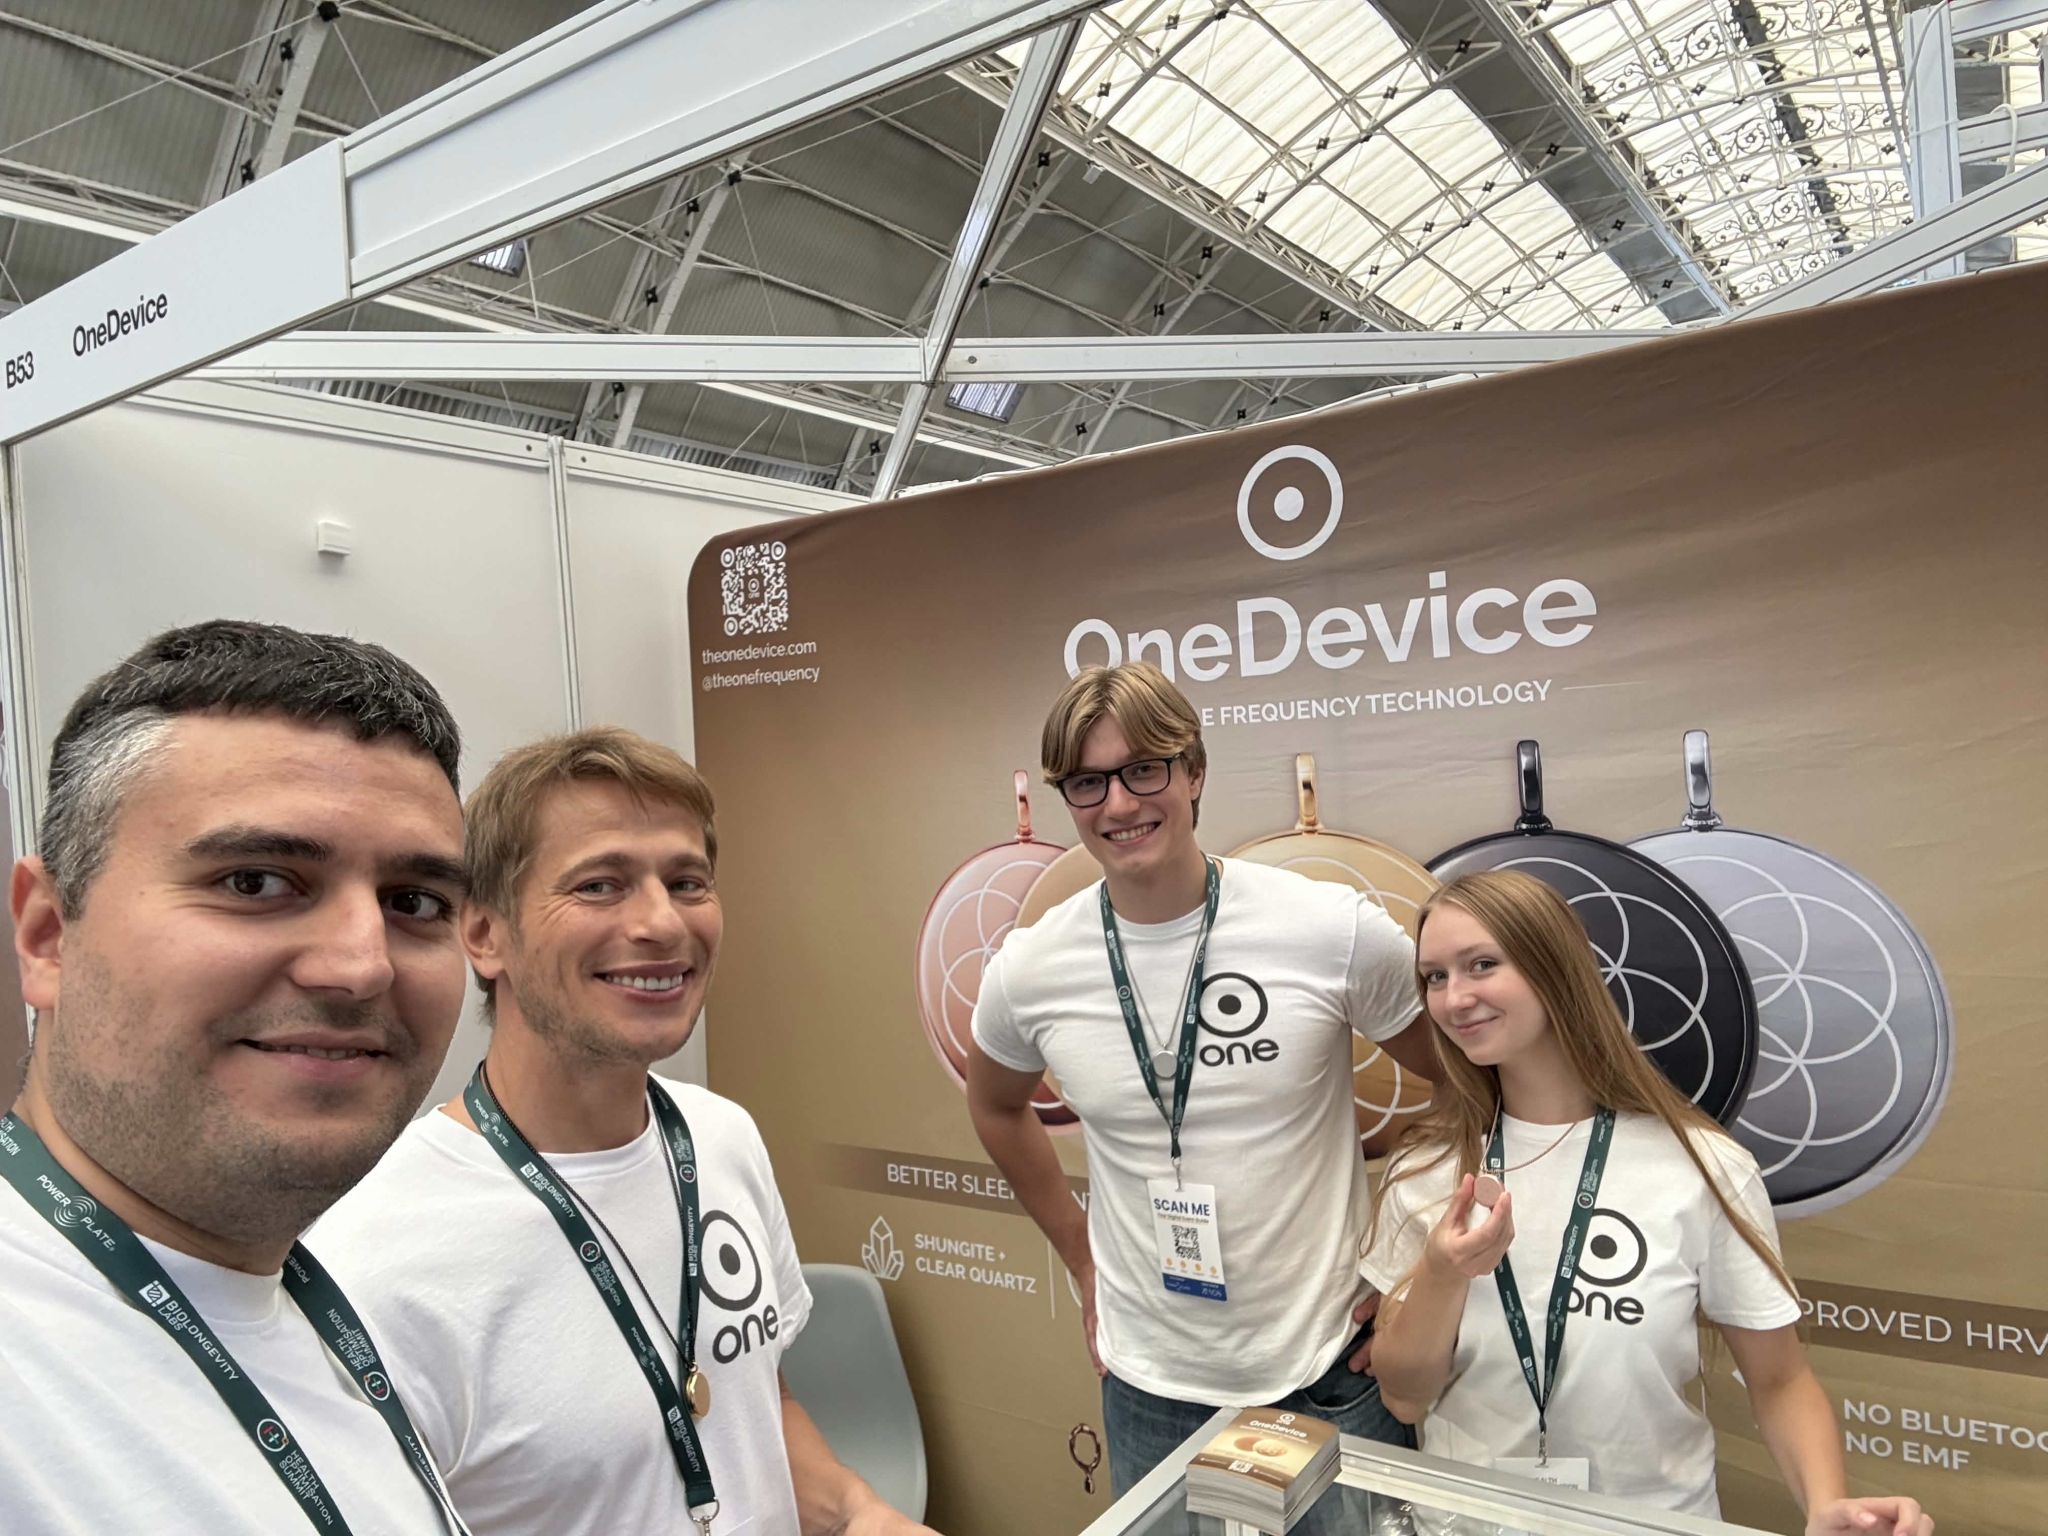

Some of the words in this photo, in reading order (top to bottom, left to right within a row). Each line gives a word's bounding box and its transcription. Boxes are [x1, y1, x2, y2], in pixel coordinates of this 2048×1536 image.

[6, 351, 34, 389] B53
[72, 293, 168, 356] OneDevice
[1063, 570, 1598, 683] OneDevice
[702, 641, 817, 665] theonedevice.com
[702, 667, 820, 691] @theonefrequency
[1220, 695, 1361, 726] FREQUENCY
[1366, 679, 1552, 715] TECHNOLOGY
[1199, 1038, 1280, 1068] one
[474, 1098, 489, 1120] POWER
[36, 1174, 72, 1208] POWER
[529, 1178, 545, 1192] LABS
[534, 1171, 576, 1218] BIOLONGEVITY
[887, 1163, 958, 1192] BETTER
[1154, 1198, 1188, 1214] SCAN
[1192, 1203, 1210, 1216] ME
[914, 1233, 995, 1262] SHUNGITE
[915, 1257, 966, 1280] CLEAR
[969, 1267, 1037, 1294] QUARTZ
[158, 1307, 183, 1331] LABS
[712, 1303, 779, 1365] one
[1800, 1298, 1952, 1344] PROVED
[1966, 1321, 2048, 1356] HRV
[165, 1300, 239, 1380] BIOLONGEVITY
[326, 1308, 370, 1368] OPTIMISATION
[335, 1338, 364, 1371] HEALTH
[351, 1328, 376, 1364] SUMMIT
[630, 1326, 647, 1353] POWER
[1844, 1398, 1891, 1426] NO
[676, 1419, 702, 1473] BIOLONGEVITY
[1845, 1431, 1893, 1457] NO
[1903, 1441, 1970, 1470] EMF
[279, 1460, 311, 1500] SUMMIT
[290, 1449, 320, 1490] HEALTH
[285, 1455, 333, 1526] OPTIMISATION
